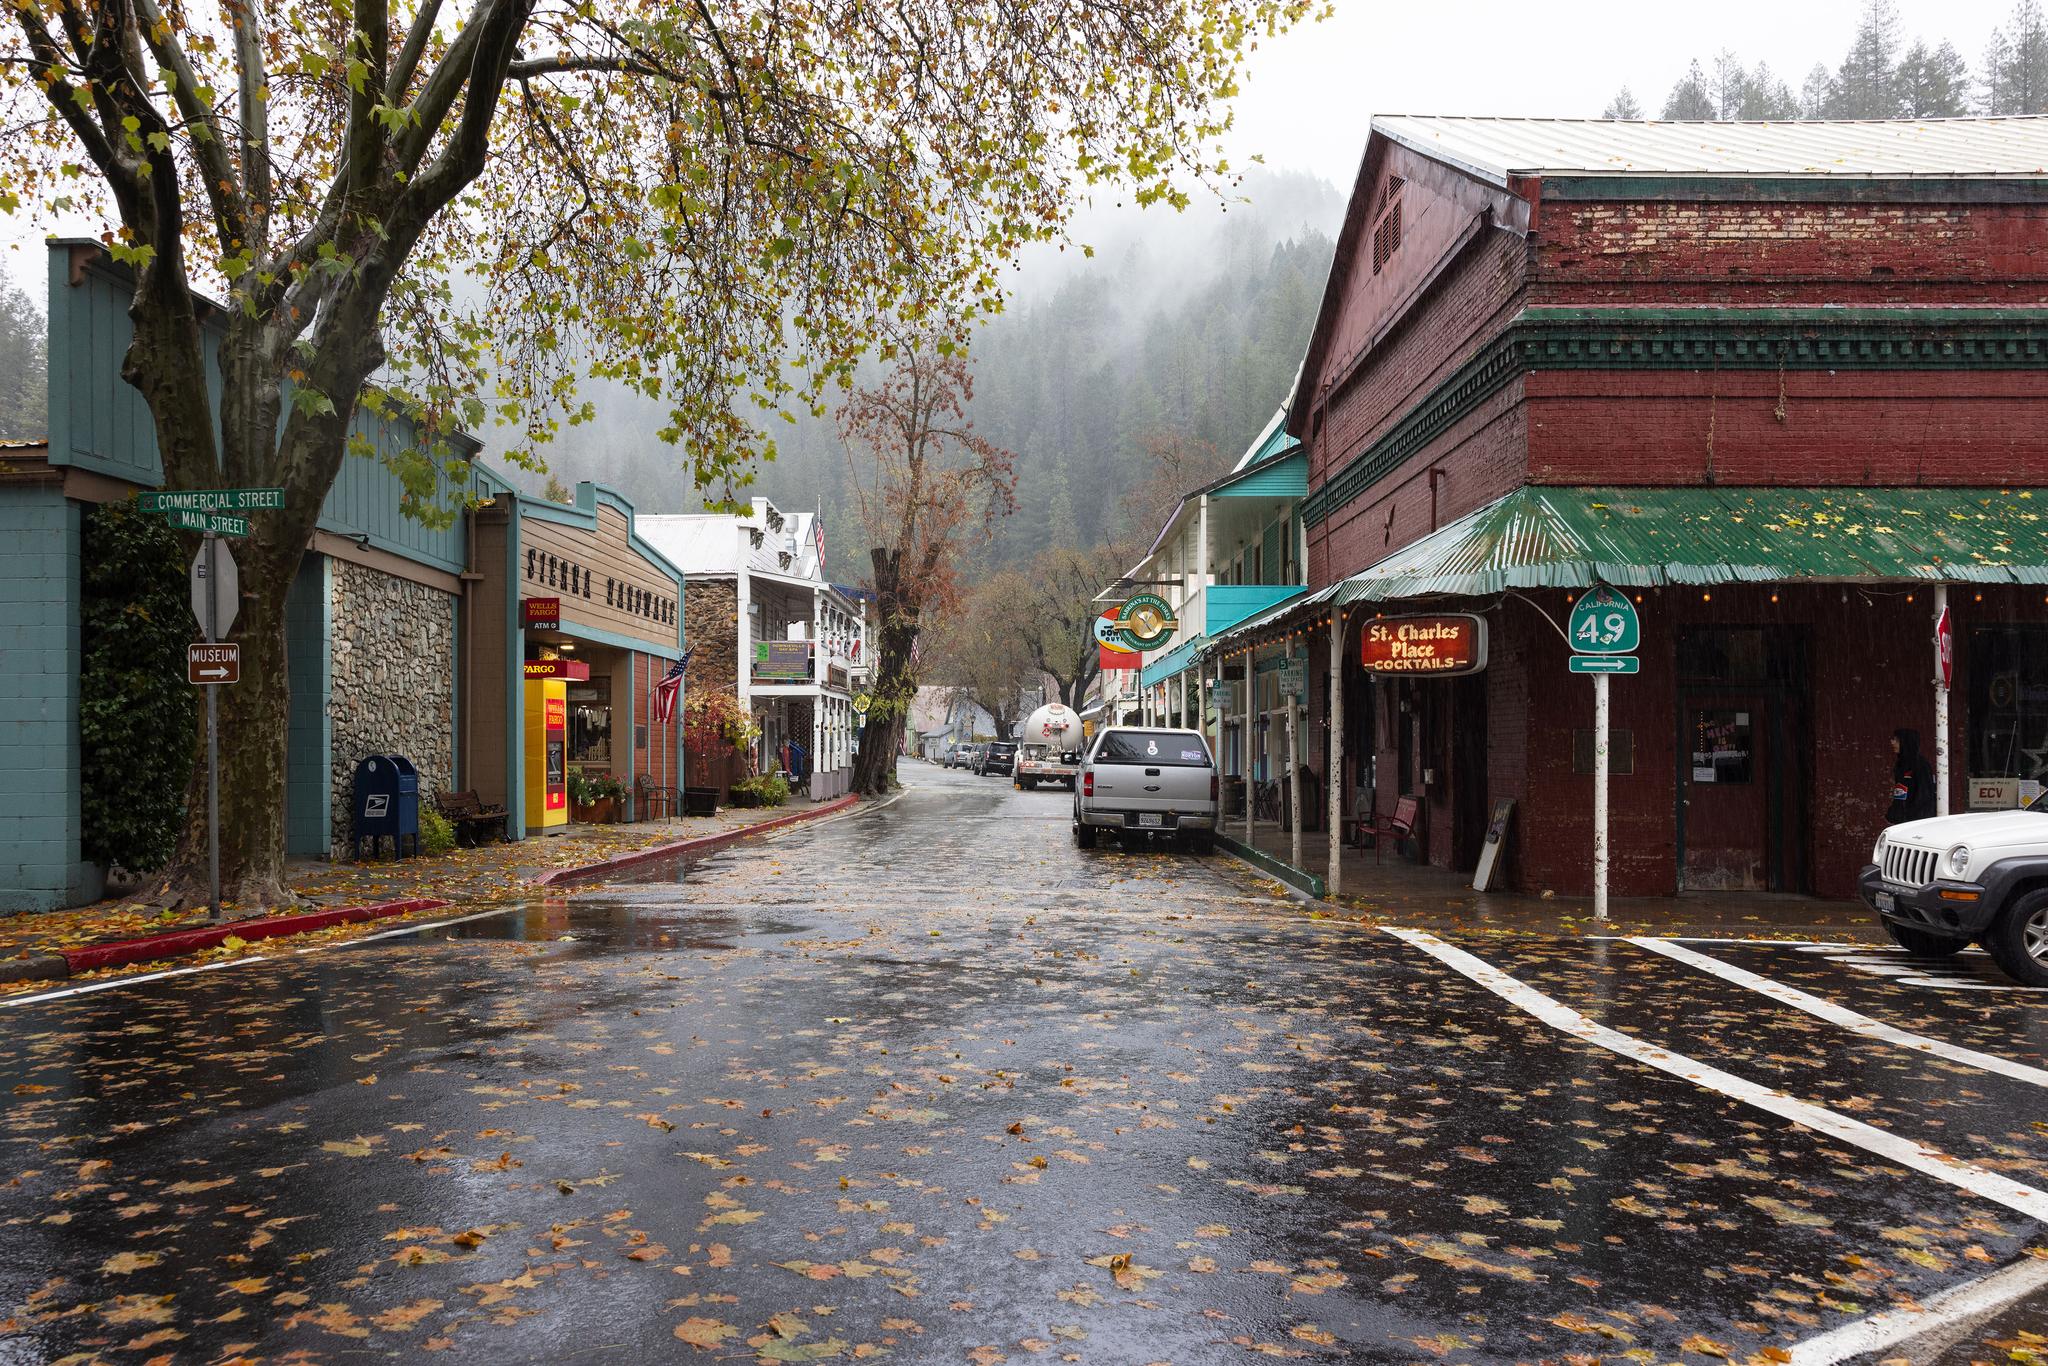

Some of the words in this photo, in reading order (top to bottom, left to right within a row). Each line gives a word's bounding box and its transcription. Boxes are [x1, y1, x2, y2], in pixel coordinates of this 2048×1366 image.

[158, 493, 233, 510] COMMERCIAL
[238, 491, 279, 507] STREET
[182, 510, 206, 529] MAIN
[211, 515, 244, 534] STREET
[527, 547, 592, 600] SIERRA
[606, 576, 675, 626] HARDWARE
[1121, 597, 1142, 620] SABRINA'S
[1150, 597, 1160, 606] THE
[1159, 602, 1172, 620] FORKS
[1578, 600, 1629, 611] CALIFORNIA
[1369, 624, 1394, 642] St.
[1397, 622, 1460, 642] Charles
[1576, 613, 1625, 644] 49
[191, 649, 238, 663] MUSEUM
[1391, 640, 1435, 659] Place
[524, 665, 556, 673] FARGO
[1280, 659, 1287, 669] 5
[1374, 657, 1455, 670] COCKTAILS
[548, 714, 563, 725] FARGO
[1979, 787, 2003, 799] ECV
